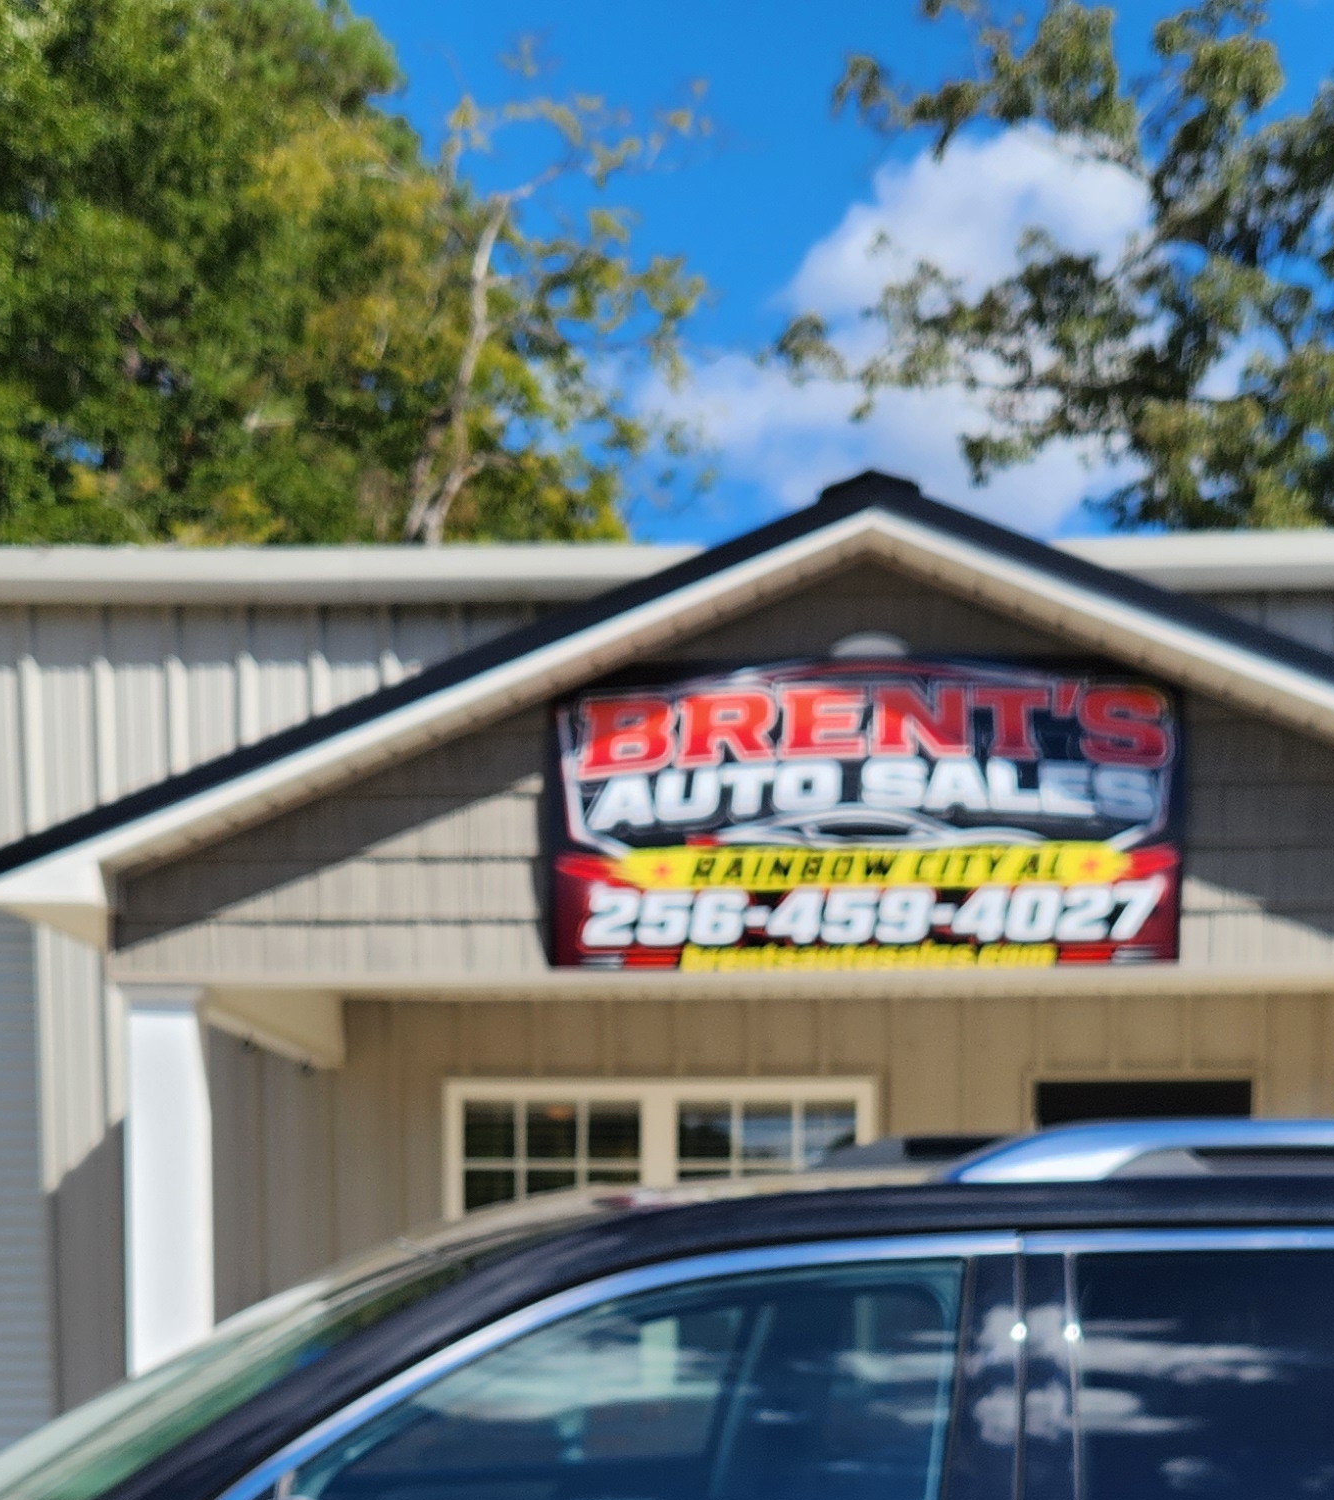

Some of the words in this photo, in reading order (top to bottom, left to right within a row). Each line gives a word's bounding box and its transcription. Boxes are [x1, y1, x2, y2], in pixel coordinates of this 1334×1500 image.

[576, 684, 1170, 781] BRENT'S
[584, 757, 844, 831] AUTO
[860, 754, 1159, 825] SALES
[692, 855, 899, 885] RAINBOW
[912, 849, 1007, 881] CITY
[582, 880, 1164, 946] 256-459-4027
